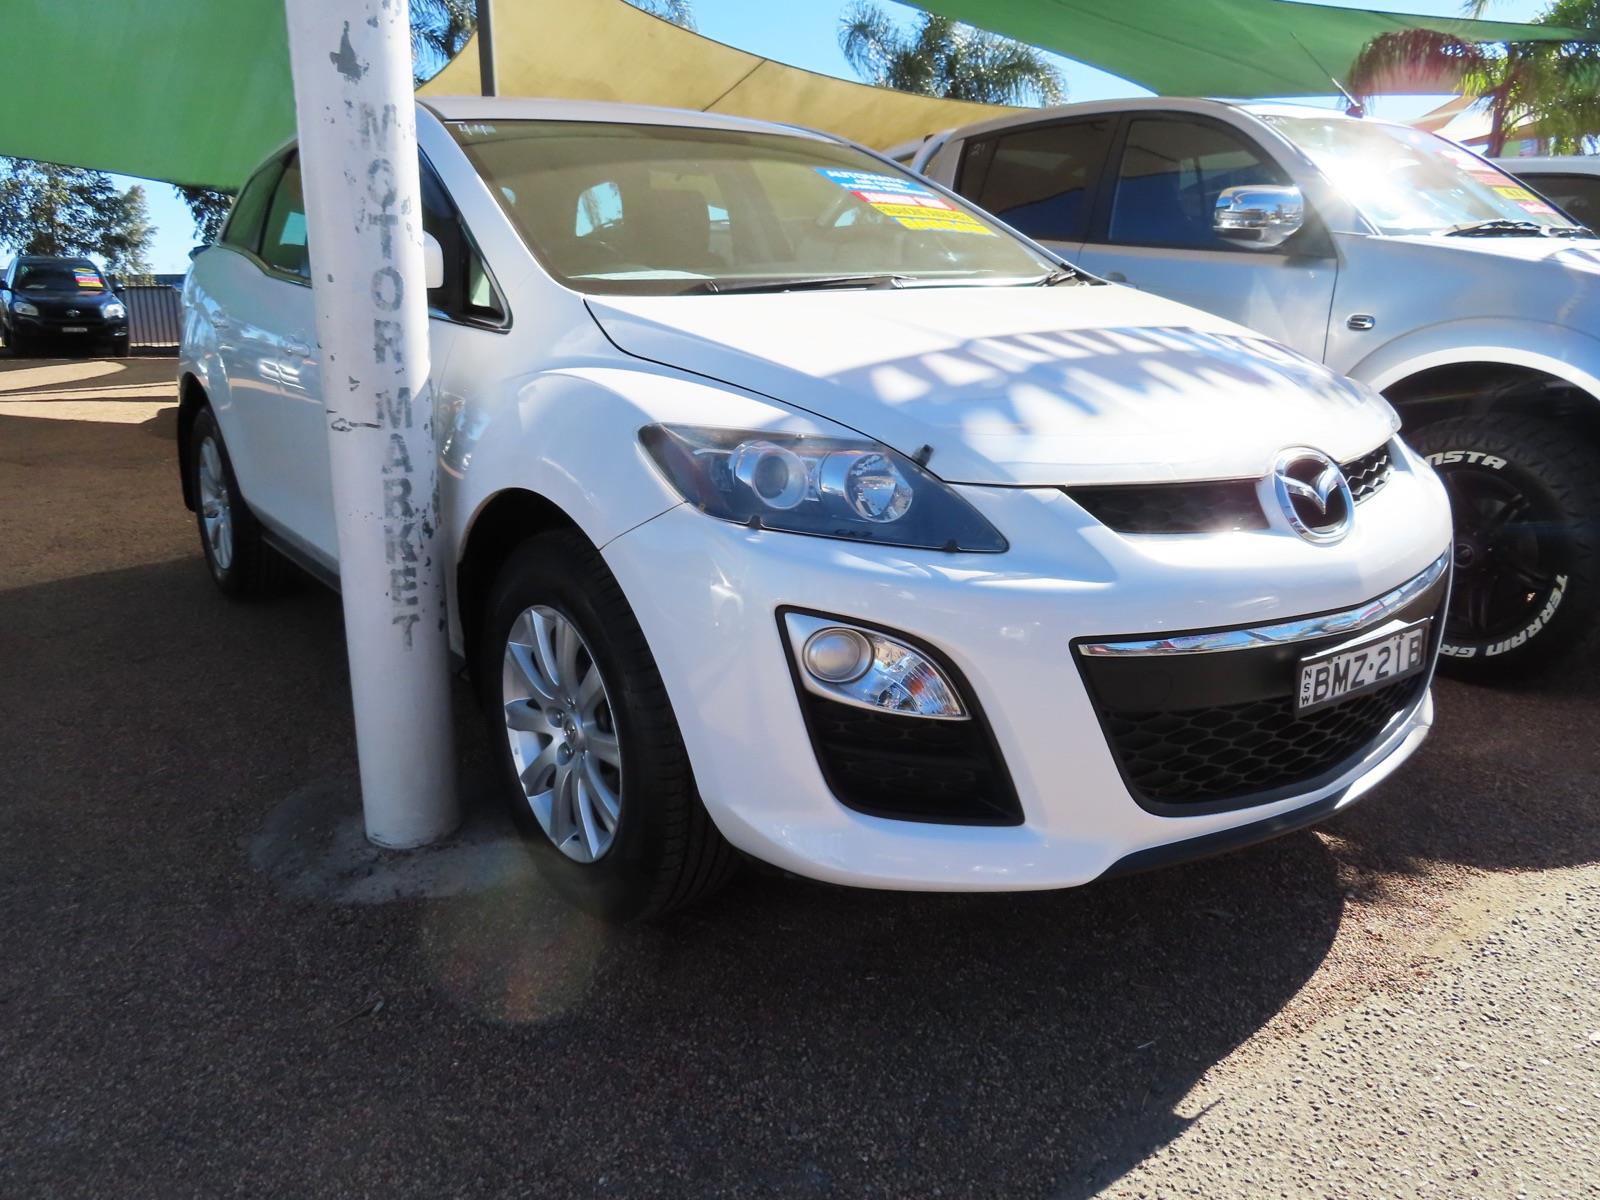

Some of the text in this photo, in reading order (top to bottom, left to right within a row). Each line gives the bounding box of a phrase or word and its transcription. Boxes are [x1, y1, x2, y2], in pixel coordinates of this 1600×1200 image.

[1424, 450, 1508, 470] NSTA
[375, 386, 421, 652] MARKET
[1439, 574, 1569, 658] TERRAIN GR
